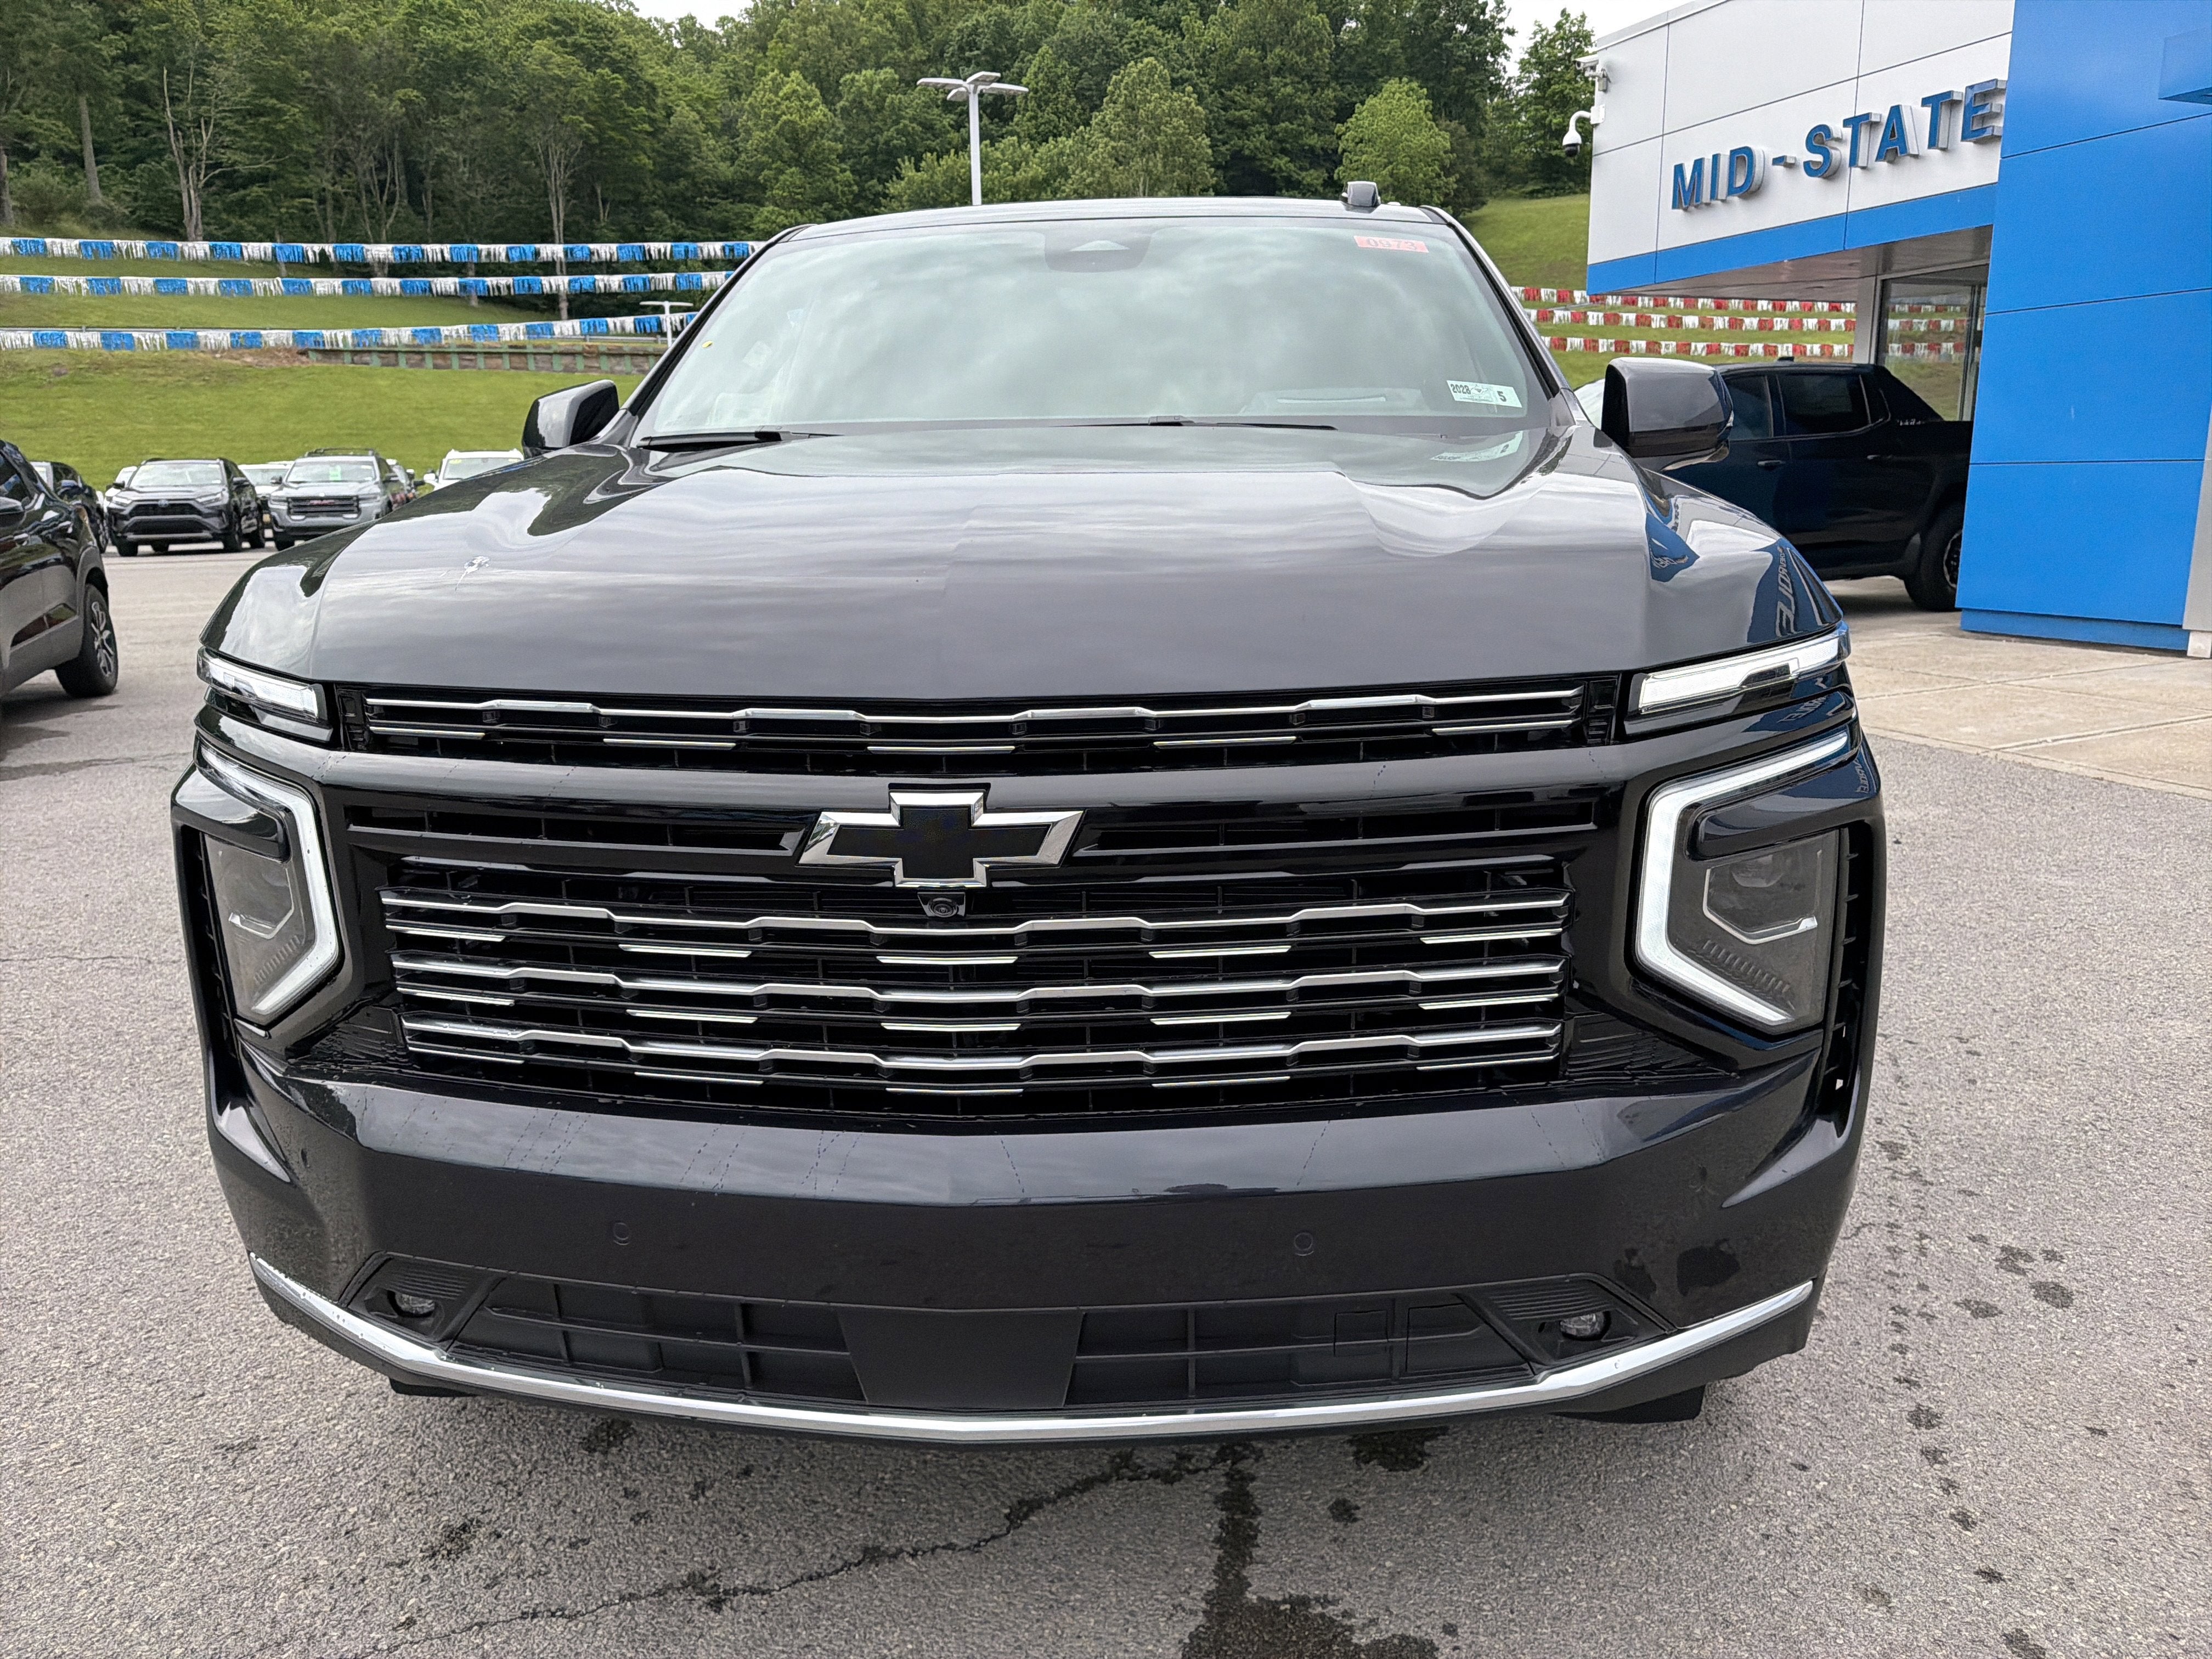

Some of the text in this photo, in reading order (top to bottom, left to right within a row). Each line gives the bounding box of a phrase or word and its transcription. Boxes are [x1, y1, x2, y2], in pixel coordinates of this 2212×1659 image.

[1671, 78, 2006, 211] MID-STATE
[1450, 383, 1471, 394] 2028
[1497, 390, 1507, 402] 5
